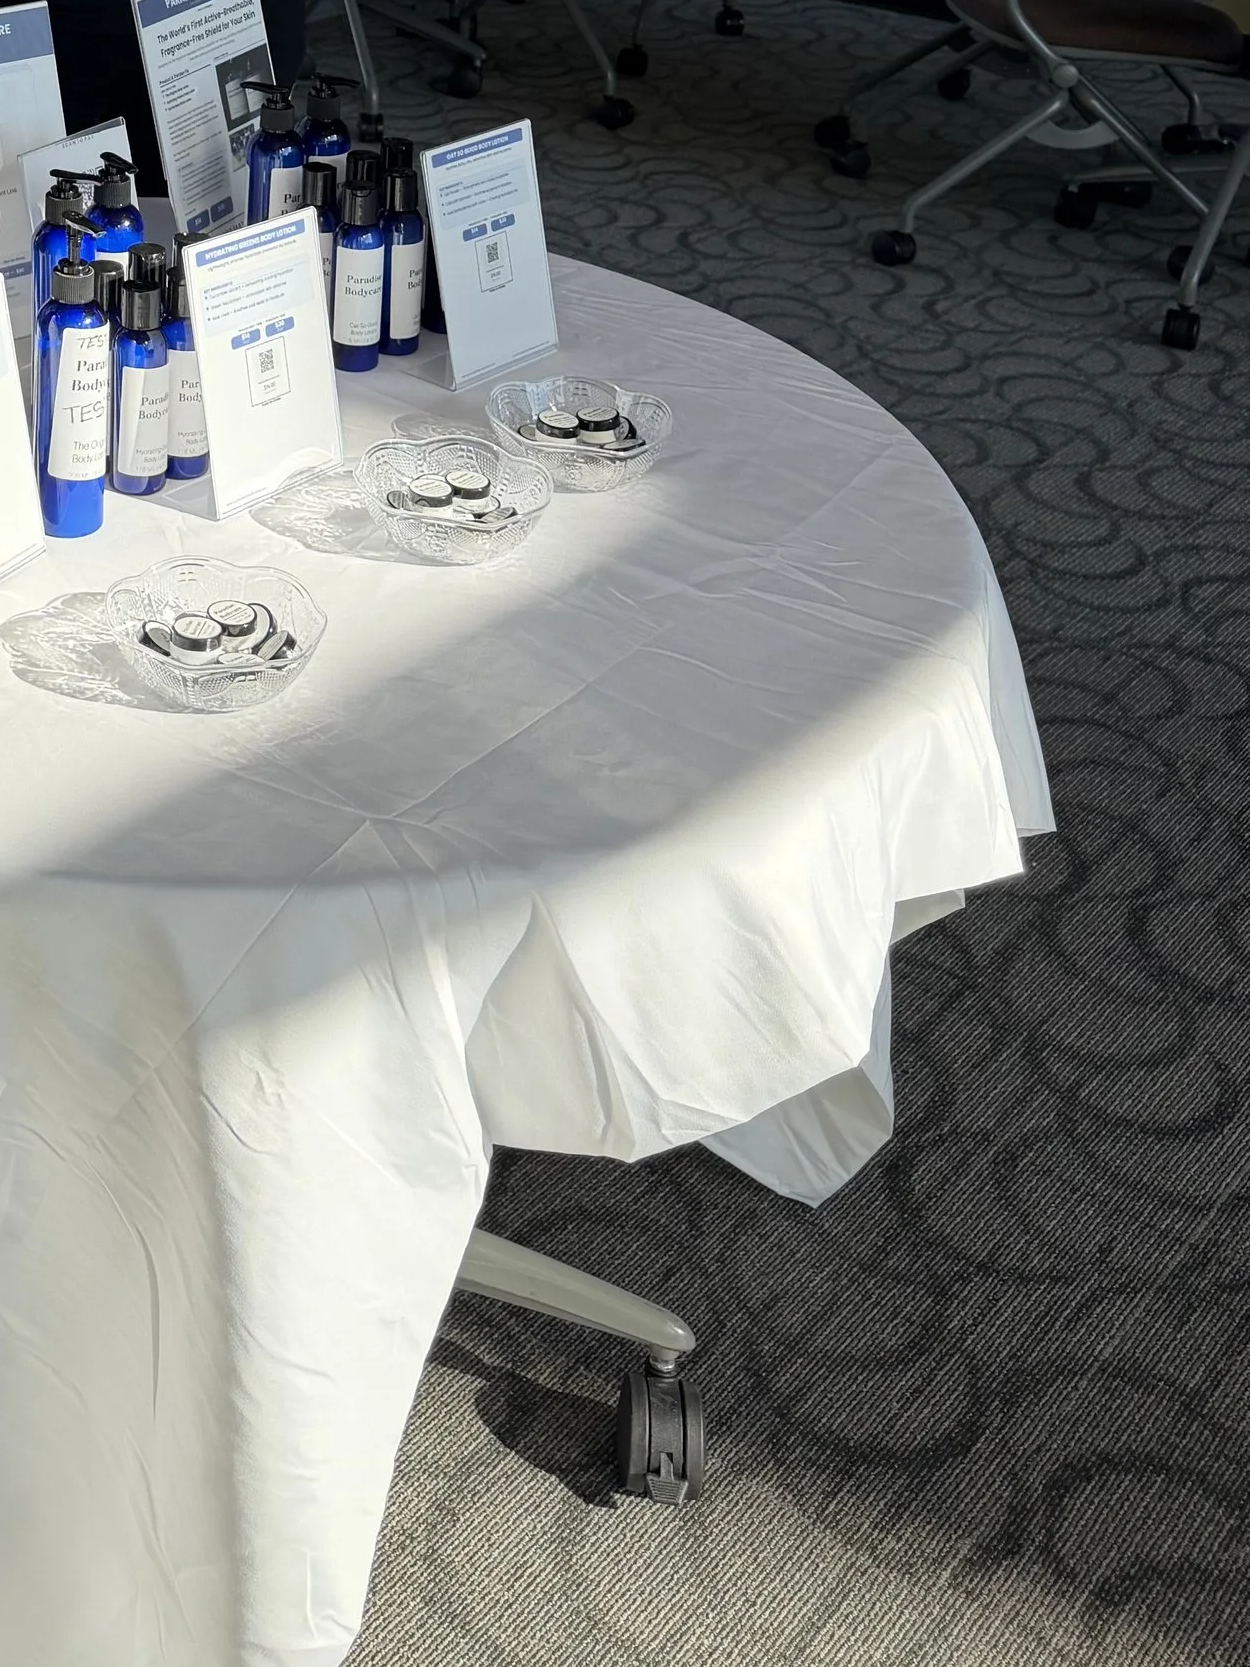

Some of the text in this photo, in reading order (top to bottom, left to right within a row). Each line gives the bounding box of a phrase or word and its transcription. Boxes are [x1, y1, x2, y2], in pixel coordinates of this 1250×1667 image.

[205, 24, 222, 38] Shield
[230, 16, 243, 28] Your
[243, 10, 256, 20] Skin
[157, 35, 168, 44] The
[284, 194, 300, 204] Par
[205, 244, 238, 260] HYDRATING
[260, 232, 275, 242] BODY
[277, 226, 296, 237] LOTION
[76, 333, 107, 349] TES
[72, 378, 107, 393] Body
[181, 380, 200, 389] Par
[141, 392, 169, 406] Parad
[62, 400, 106, 424] TES
[74, 440, 90, 450] The
[72, 453, 92, 464] Body
